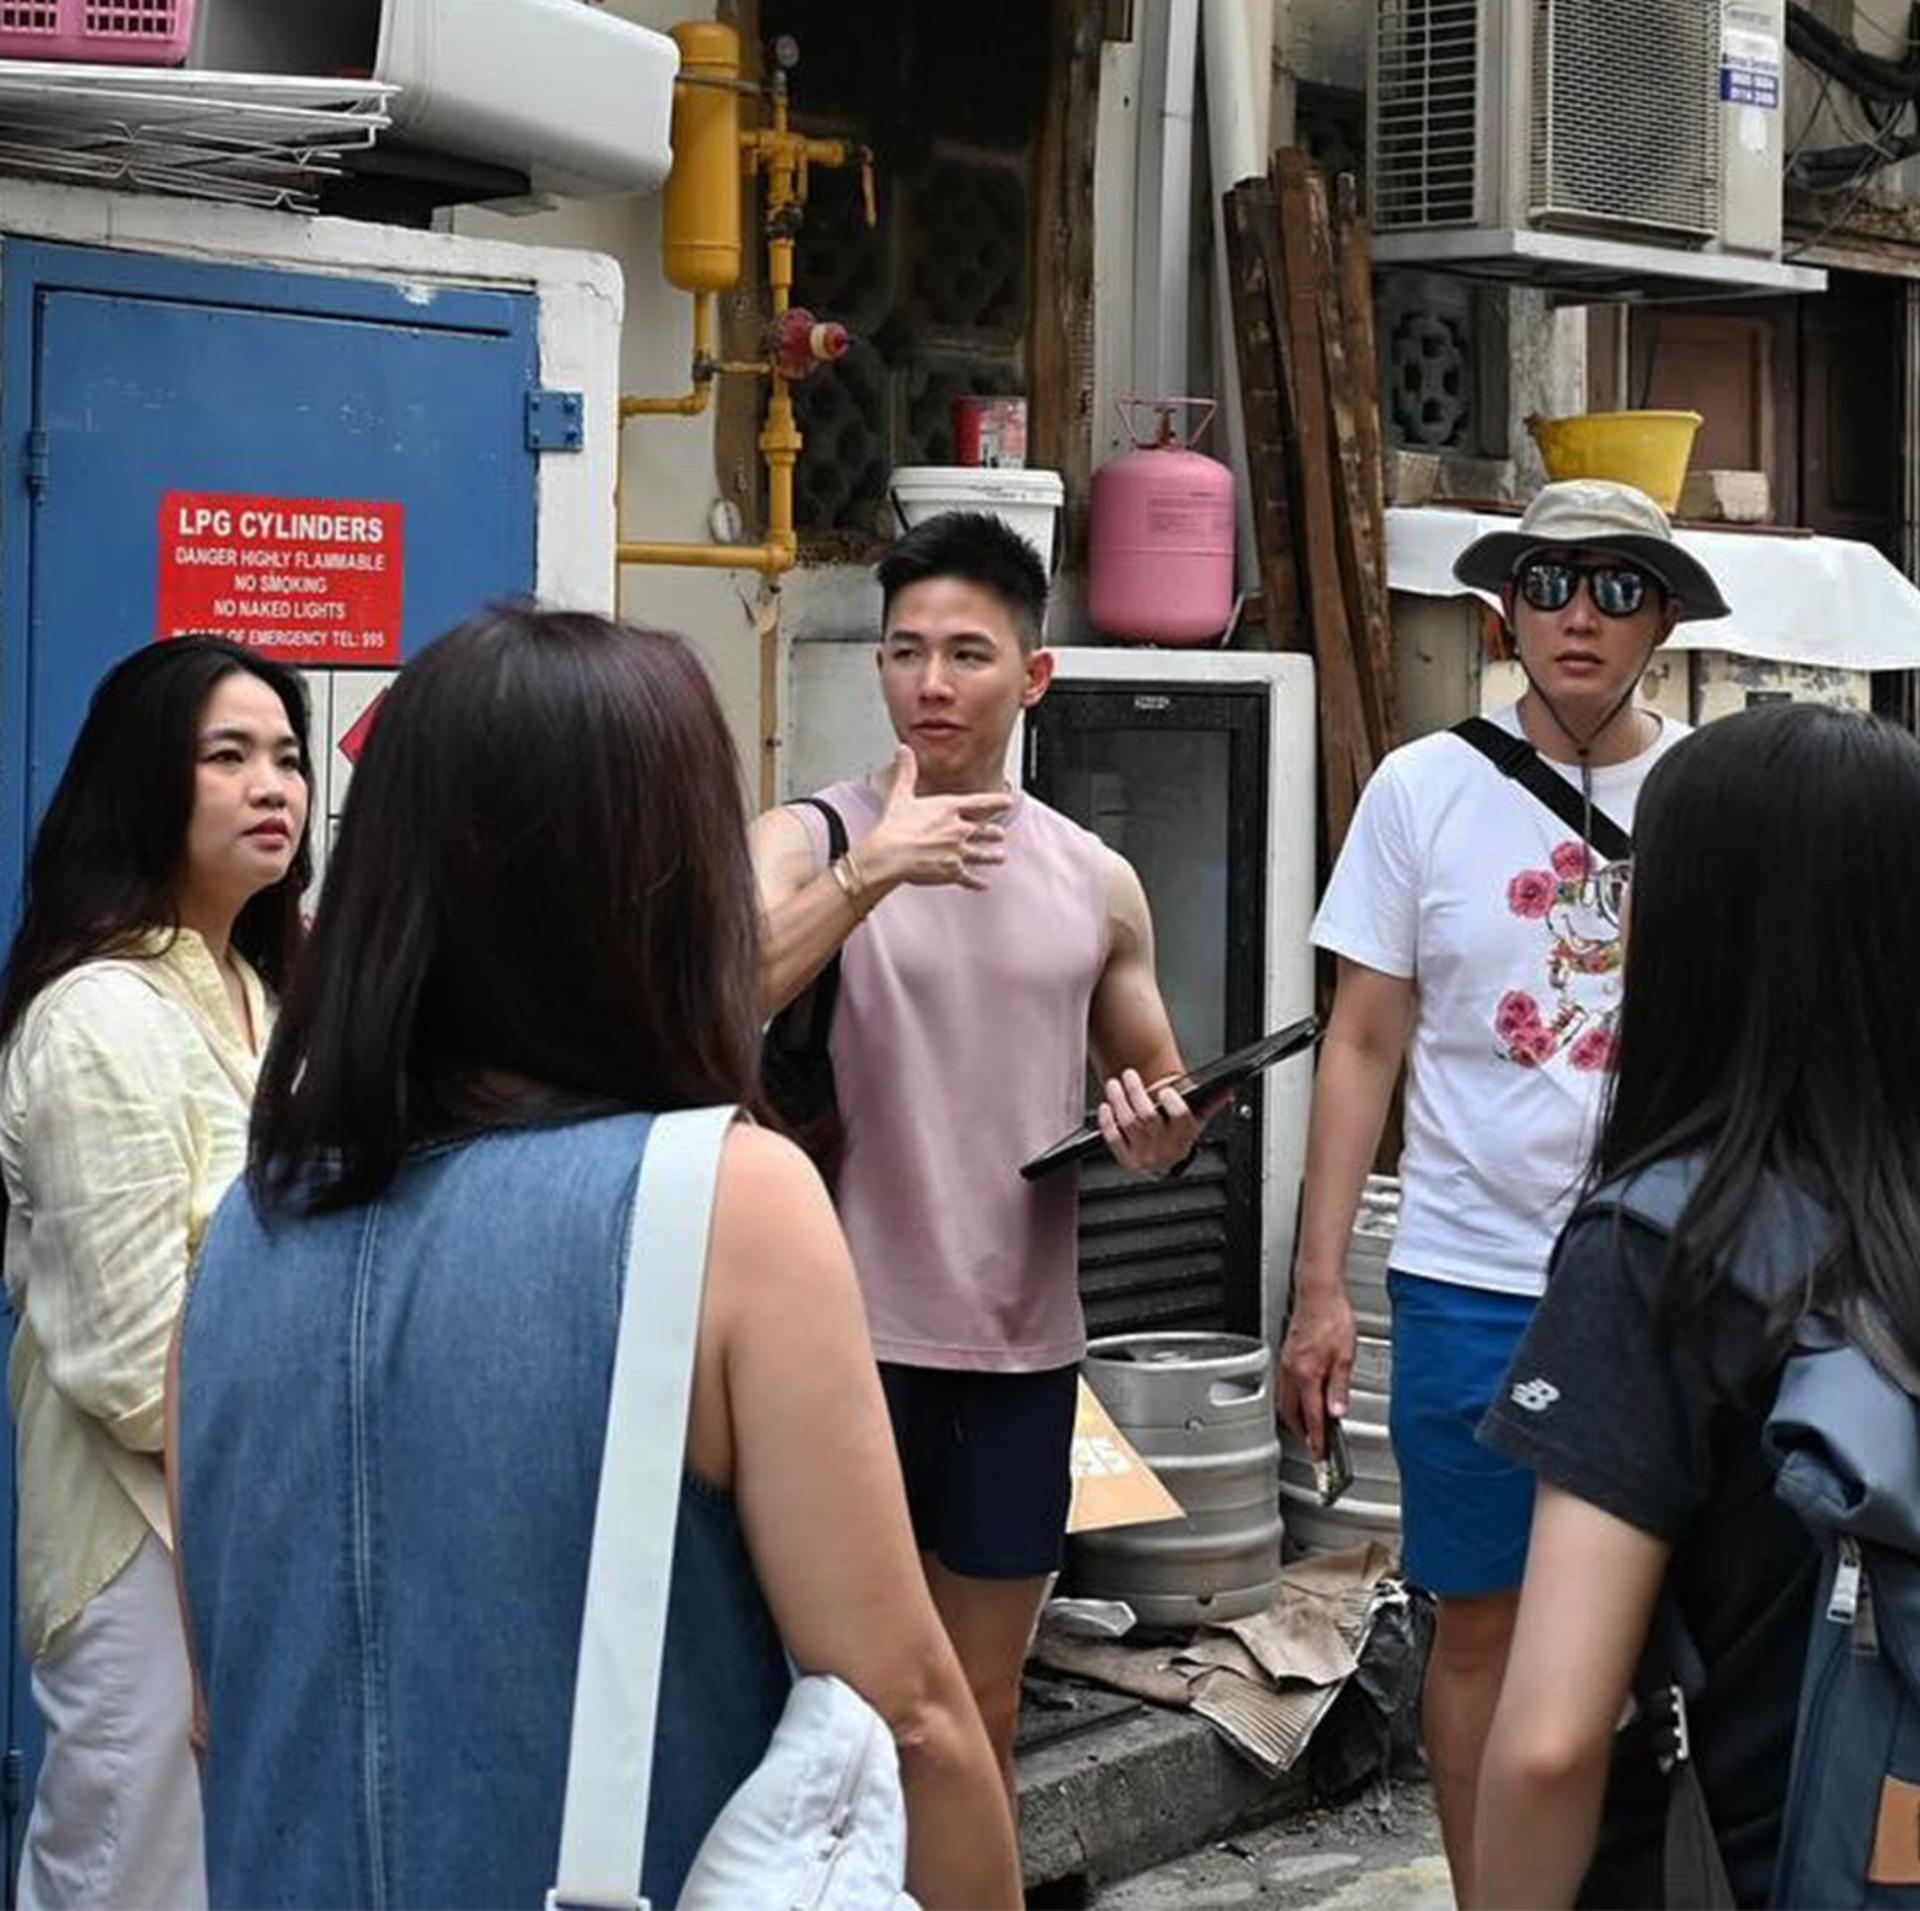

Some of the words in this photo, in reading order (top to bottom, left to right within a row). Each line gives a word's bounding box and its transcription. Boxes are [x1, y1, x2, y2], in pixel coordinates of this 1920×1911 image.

[180, 508, 231, 537] LPG
[240, 511, 384, 543] CYLINDERS
[175, 547, 238, 567] DANGER
[241, 550, 292, 569] HIGHLY
[294, 551, 385, 572] FLAMMABLE
[234, 575, 257, 592] NO
[260, 575, 328, 594] SMOKING
[214, 600, 236, 617] NO
[239, 601, 291, 618] NAKED
[294, 602, 346, 620] LIGHTS
[249, 629, 328, 647] EMERGENCY
